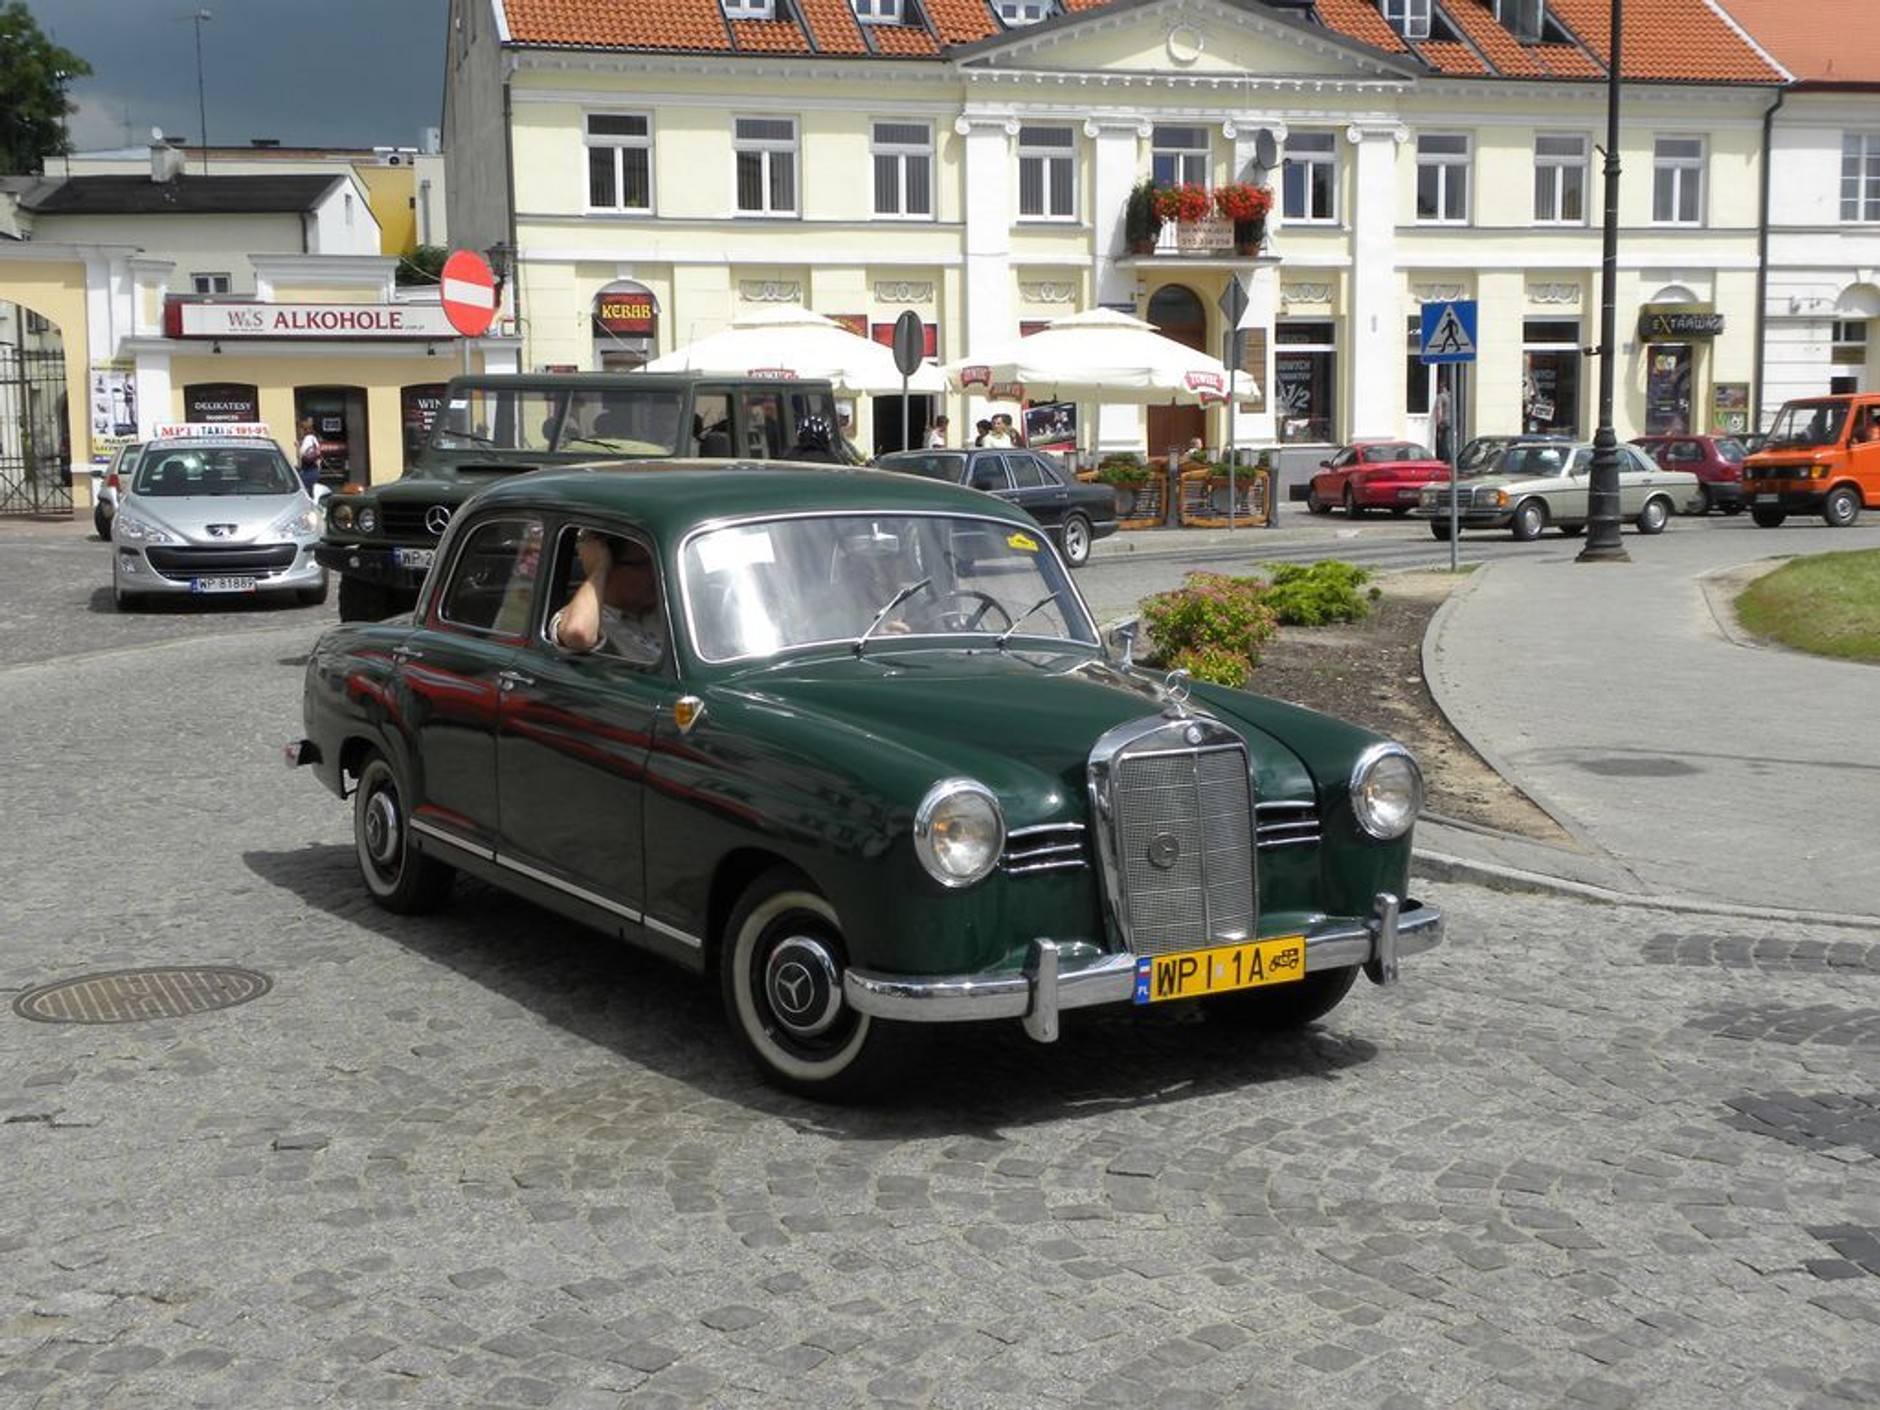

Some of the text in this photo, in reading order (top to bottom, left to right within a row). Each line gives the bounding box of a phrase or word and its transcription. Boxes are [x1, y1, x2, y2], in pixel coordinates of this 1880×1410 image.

[602, 305, 651, 318] KEBAB
[273, 311, 403, 329] ALKOHOLE
[194, 402, 251, 411] DELIKATESY
[416, 398, 442, 409] WIN
[1232, 947, 1265, 986] 1A
